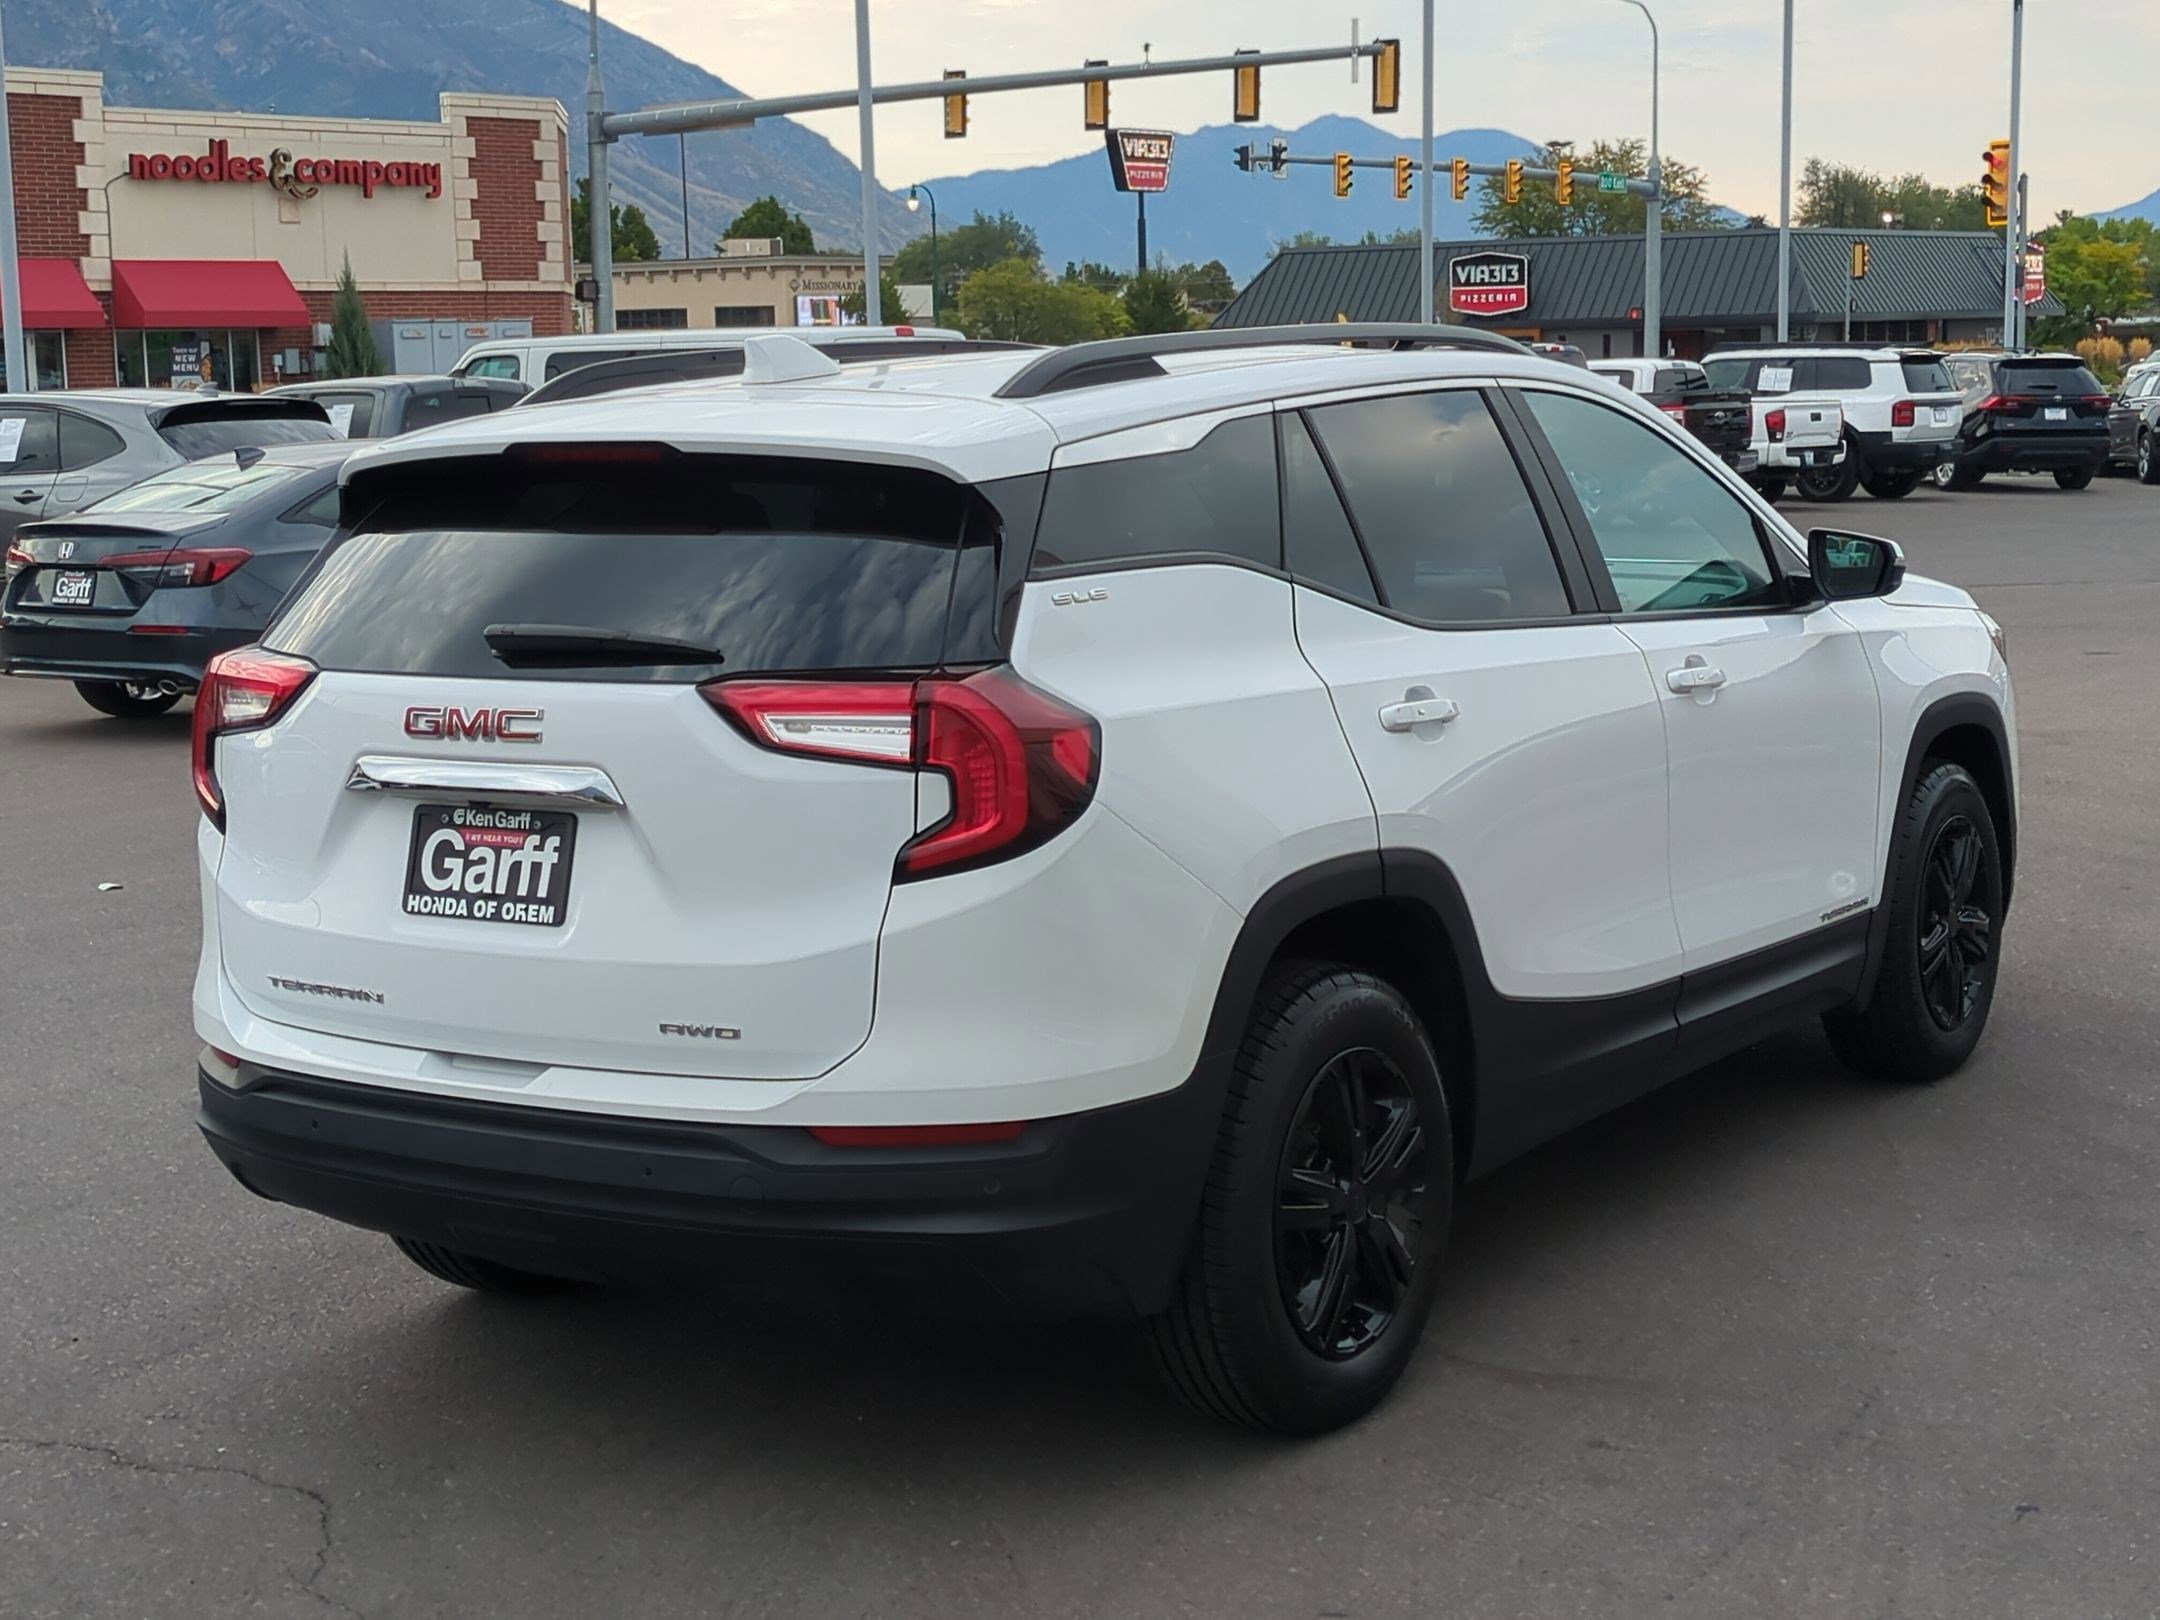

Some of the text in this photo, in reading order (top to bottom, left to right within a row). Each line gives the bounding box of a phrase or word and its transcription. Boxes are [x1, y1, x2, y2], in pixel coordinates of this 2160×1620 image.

[1123, 138, 1168, 158] VIA313
[129, 138, 441, 199] noodles & company
[1455, 264, 1519, 284] VIA313
[1460, 293, 1517, 303] PIZZERIA
[172, 363, 200, 372] MENU
[175, 354, 197, 363] NEW
[56, 577, 92, 598] Garff
[1051, 587, 1109, 606] SLE
[404, 706, 544, 743] GMC
[466, 809, 493, 827] Ken
[495, 811, 531, 830] Garff
[421, 828, 560, 898] Garff
[407, 894, 555, 924] HONDA OF OREM
[659, 1023, 742, 1040] AWD
